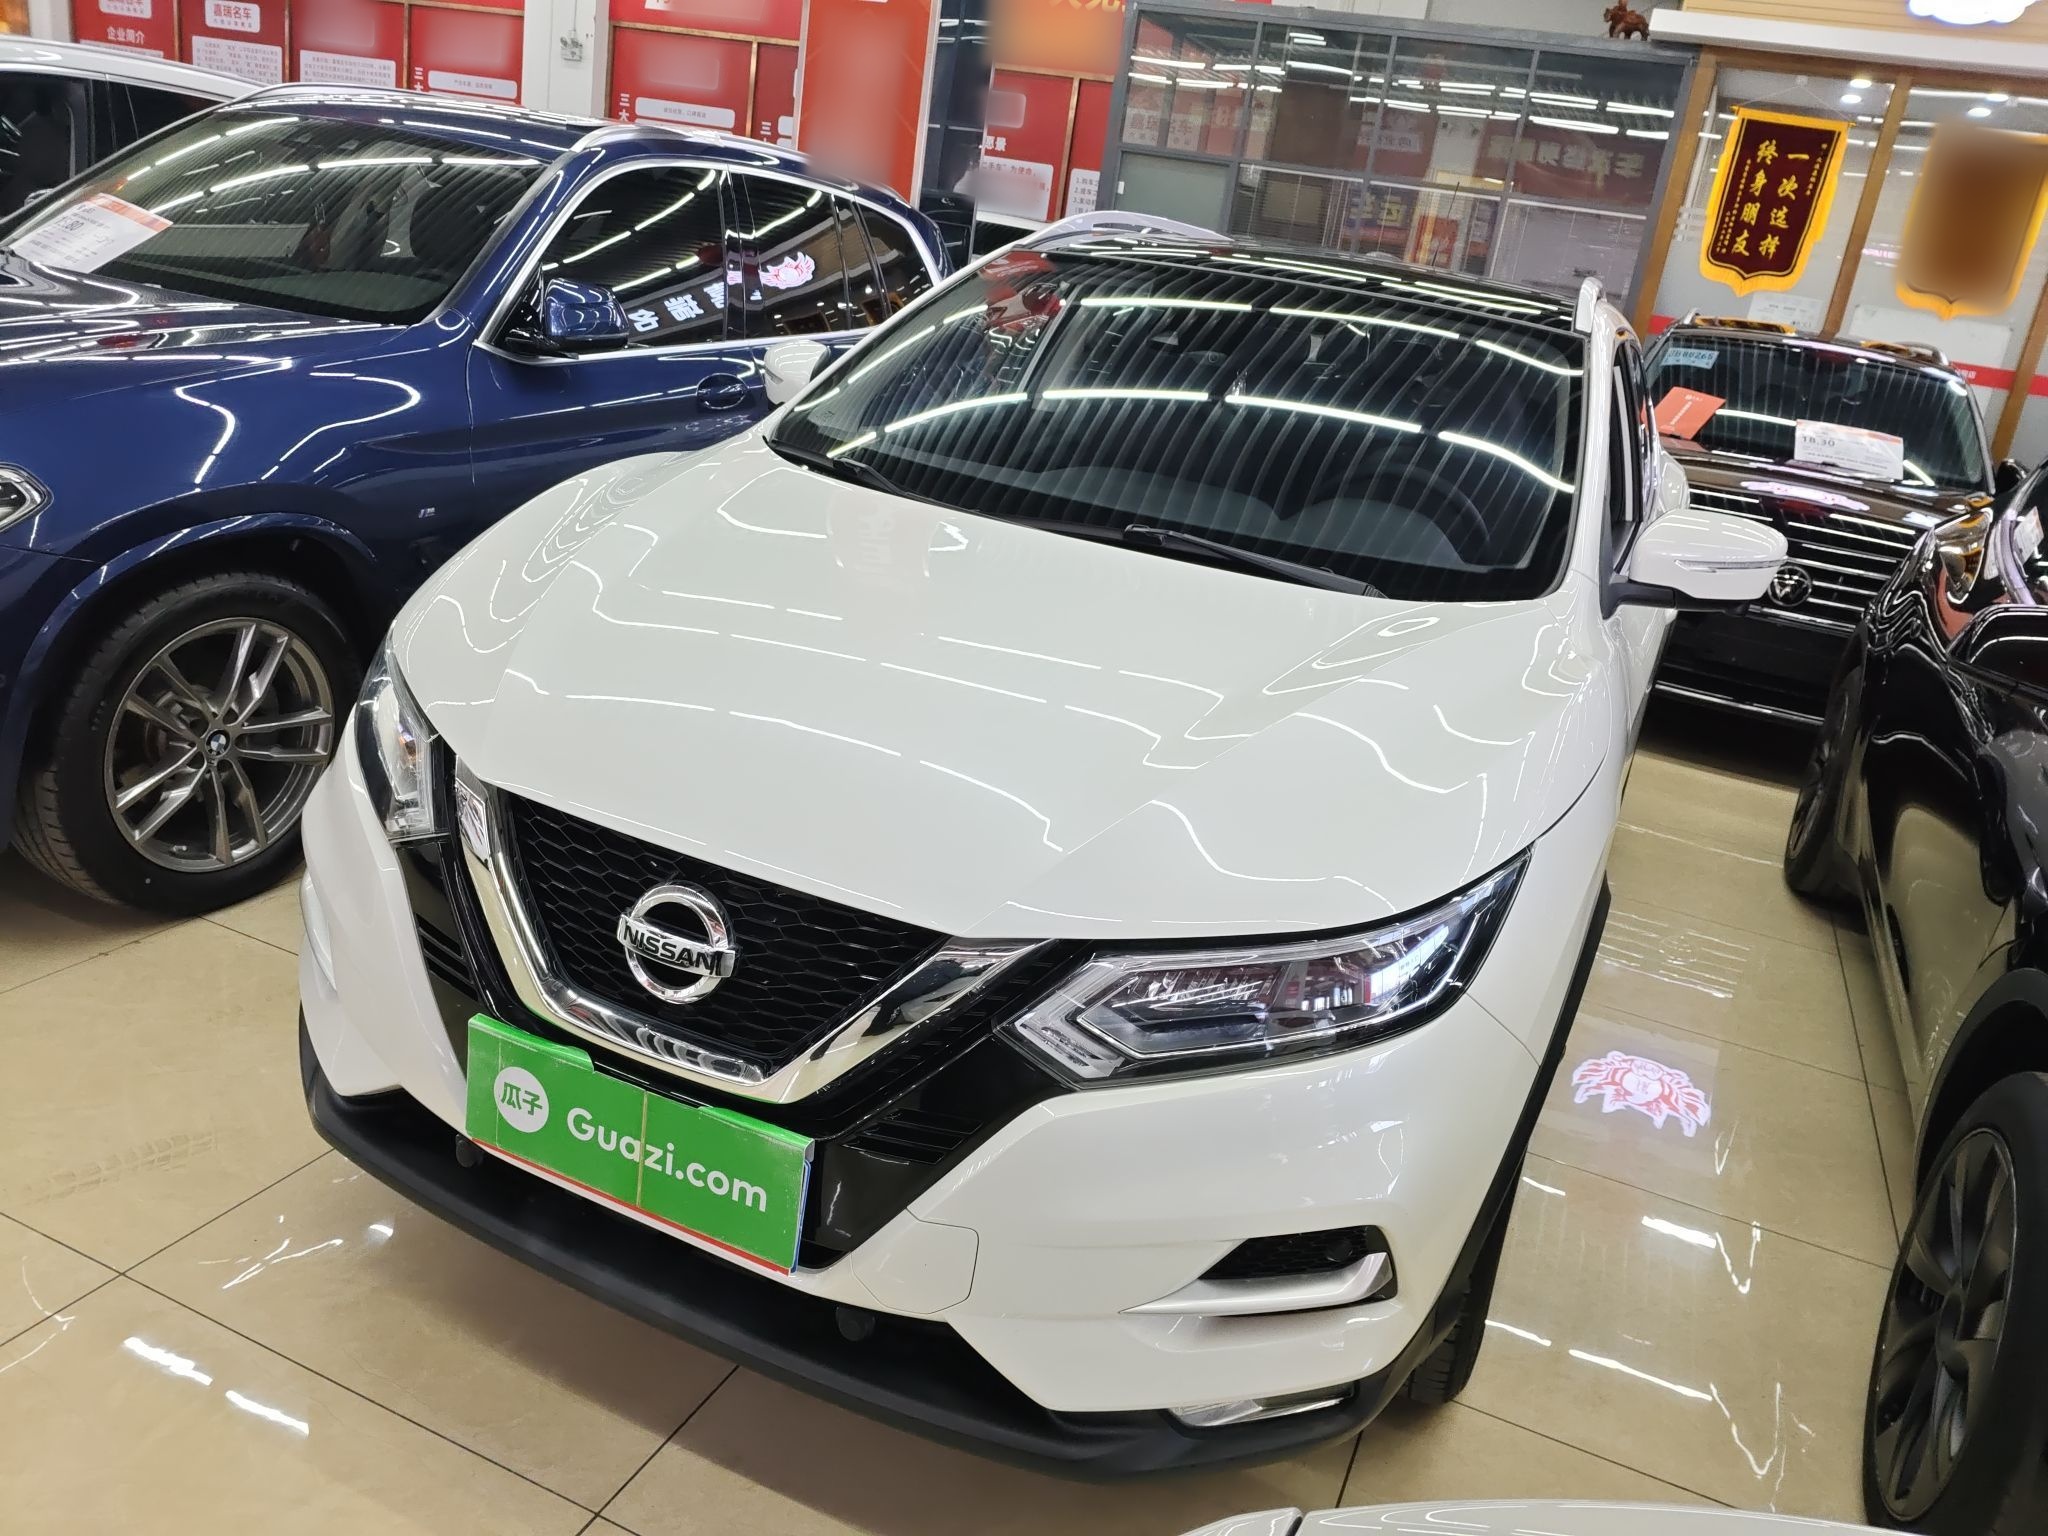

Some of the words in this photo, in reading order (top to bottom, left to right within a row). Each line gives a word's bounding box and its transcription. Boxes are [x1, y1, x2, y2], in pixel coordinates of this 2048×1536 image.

[106, 25, 145, 45] 企业简介
[213, 3, 253, 20] 嘉瑞名车
[1731, 139, 1779, 257] 终身朋友
[1758, 153, 1810, 260] 一次选择
[623, 924, 723, 977] NISSAN
[501, 1081, 543, 1116] 瓜子
[566, 1107, 768, 1213] Guazi.com
